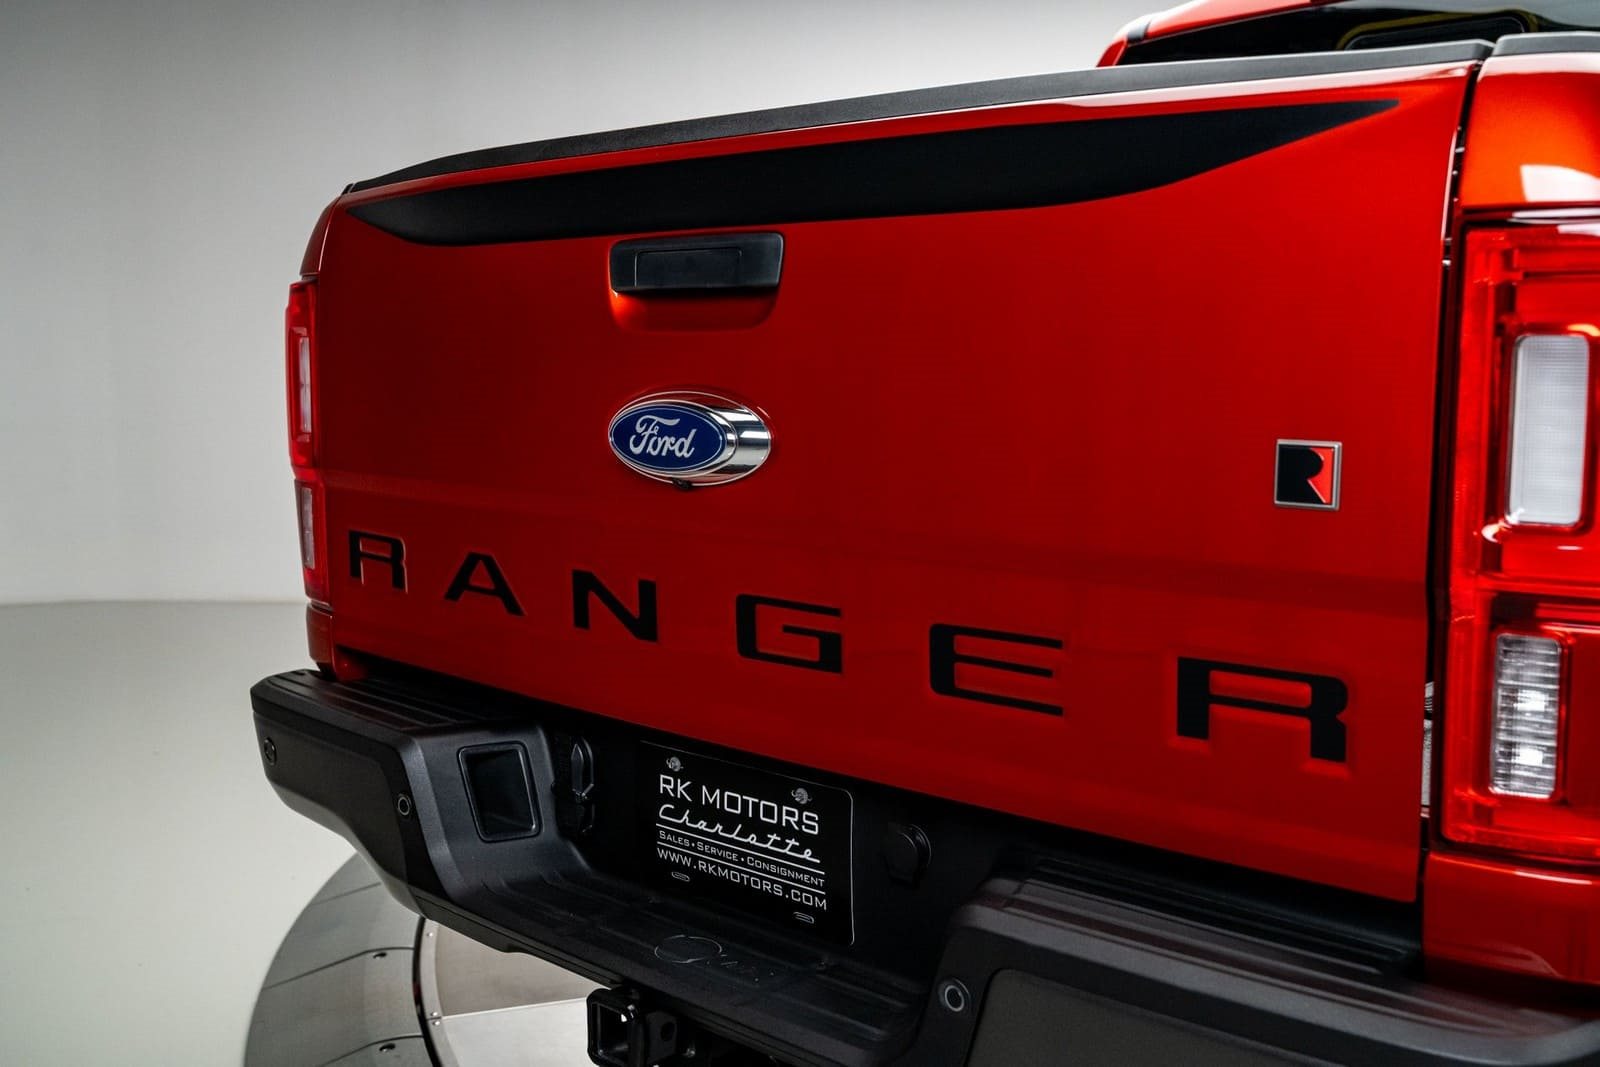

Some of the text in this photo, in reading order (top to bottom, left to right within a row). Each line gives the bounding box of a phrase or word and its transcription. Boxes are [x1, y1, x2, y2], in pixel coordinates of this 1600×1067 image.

[630, 415, 697, 458] Ford
[1279, 444, 1325, 504] R
[349, 530, 1349, 763] RANGER
[659, 774, 819, 835] RK MOTORS
[659, 804, 820, 863] Charlotte
[657, 847, 827, 911] WWW.RKMOTORS.COM
